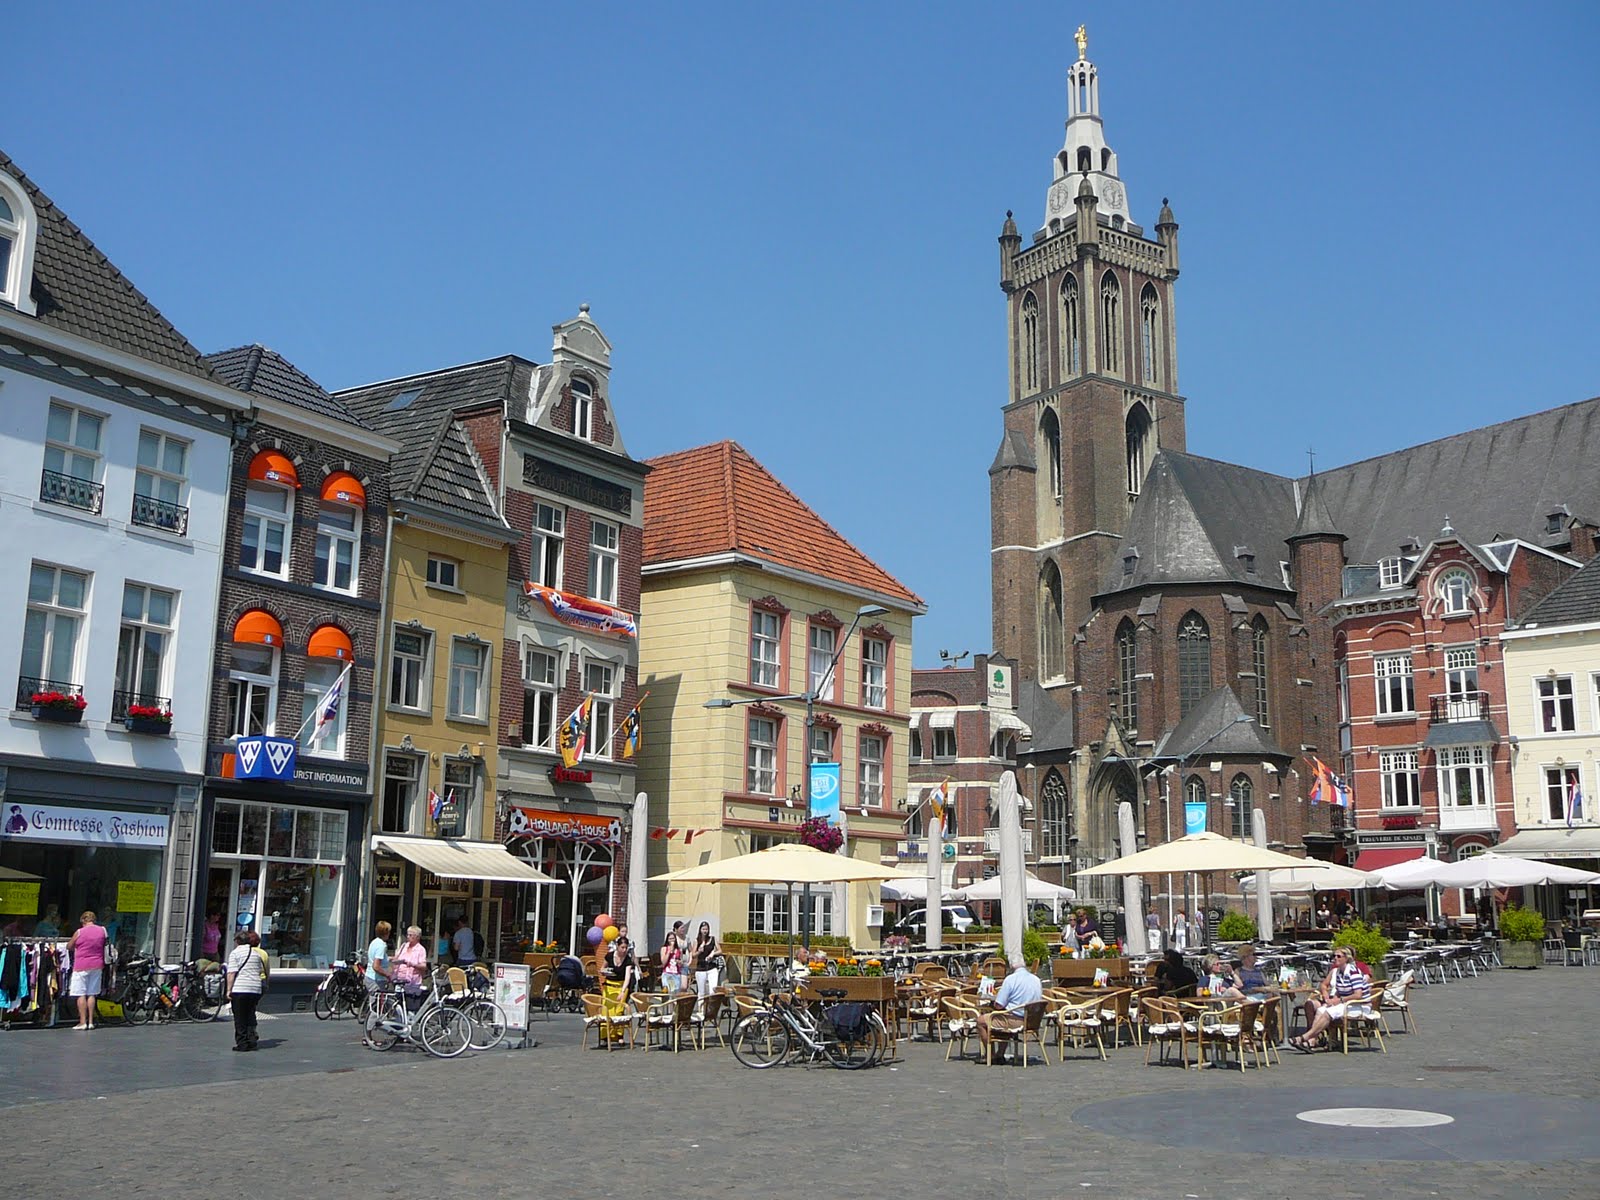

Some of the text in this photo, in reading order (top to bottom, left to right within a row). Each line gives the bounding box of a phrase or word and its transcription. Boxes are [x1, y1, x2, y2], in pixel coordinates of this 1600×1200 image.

[539, 471, 580, 497] GOUDEN
[293, 770, 363, 785] URIST INFORMATION
[31, 809, 165, 840] Comtesse Fashion
[530, 818, 607, 837] HOLLAND HOUSE
